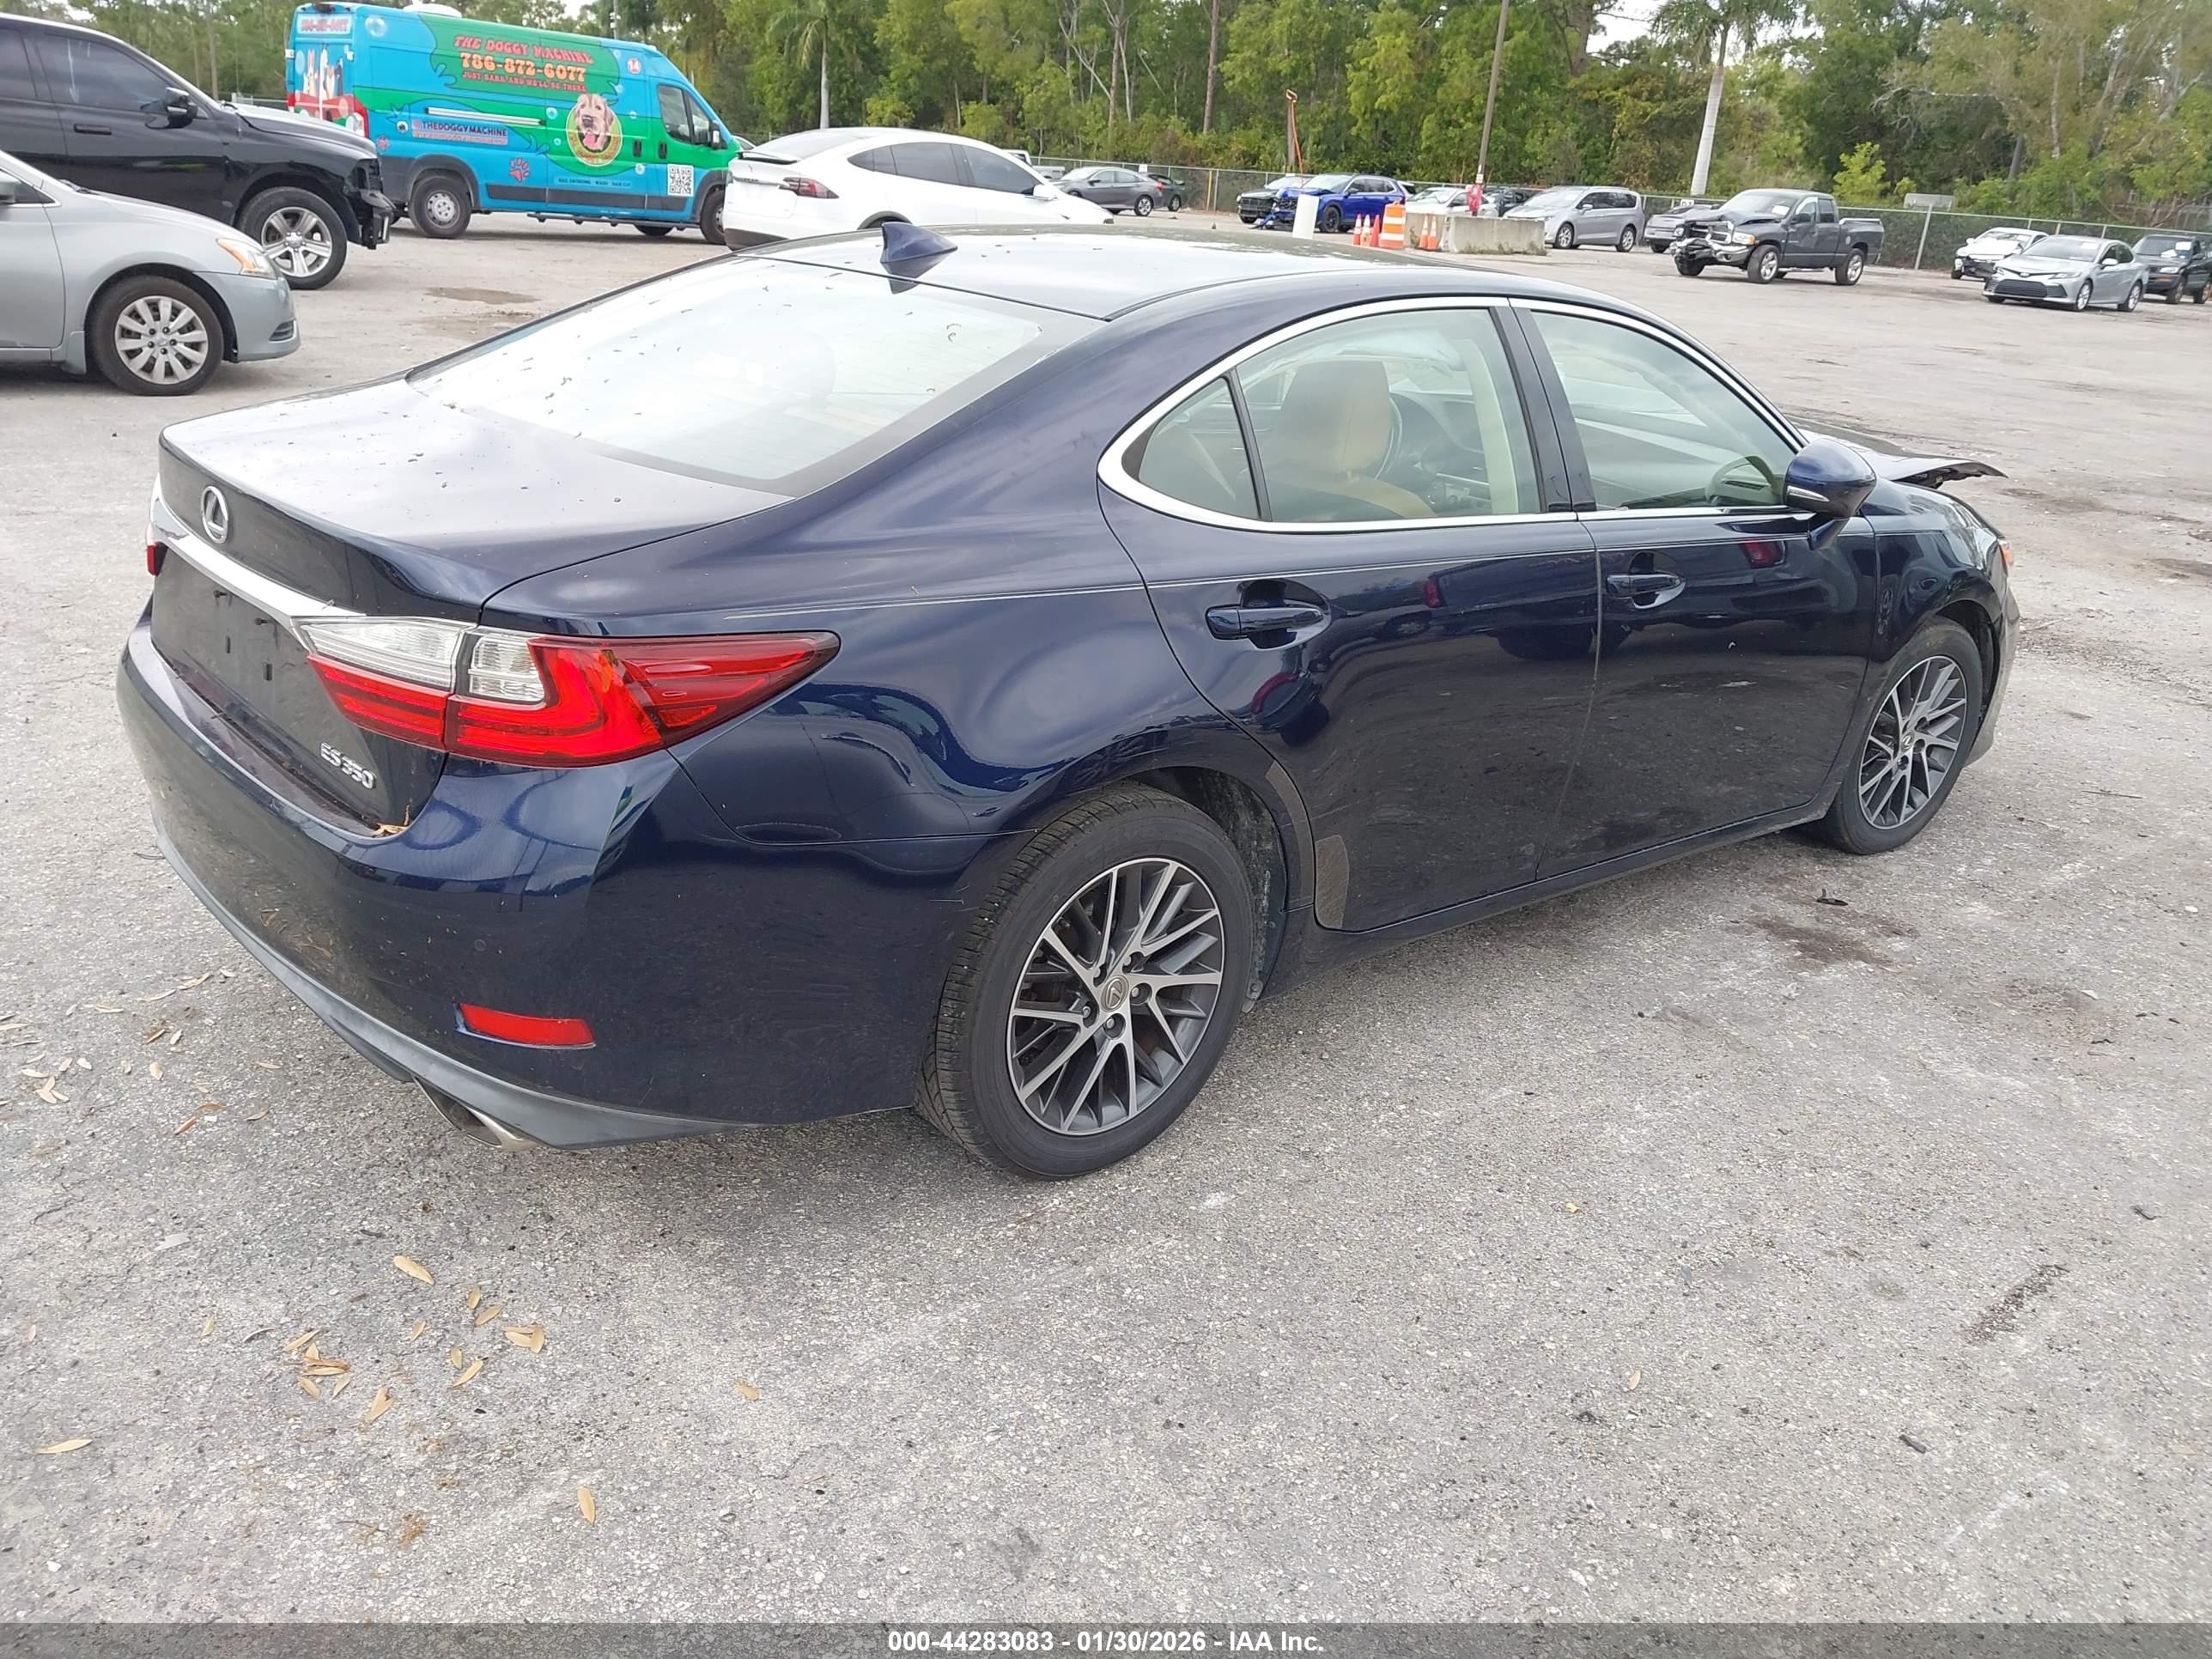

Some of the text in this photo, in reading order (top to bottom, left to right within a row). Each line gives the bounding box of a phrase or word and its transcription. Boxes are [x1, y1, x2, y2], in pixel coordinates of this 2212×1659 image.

[453, 35, 594, 64] THE DOGGY MACHINE
[460, 52, 586, 82] 786-872-6077
[462, 71, 482, 80] JUST
[508, 76, 525, 85] AND
[562, 82, 586, 92] THERE
[422, 121, 507, 137] THEDOGGYMACHINE
[320, 742, 376, 789] ES 350
